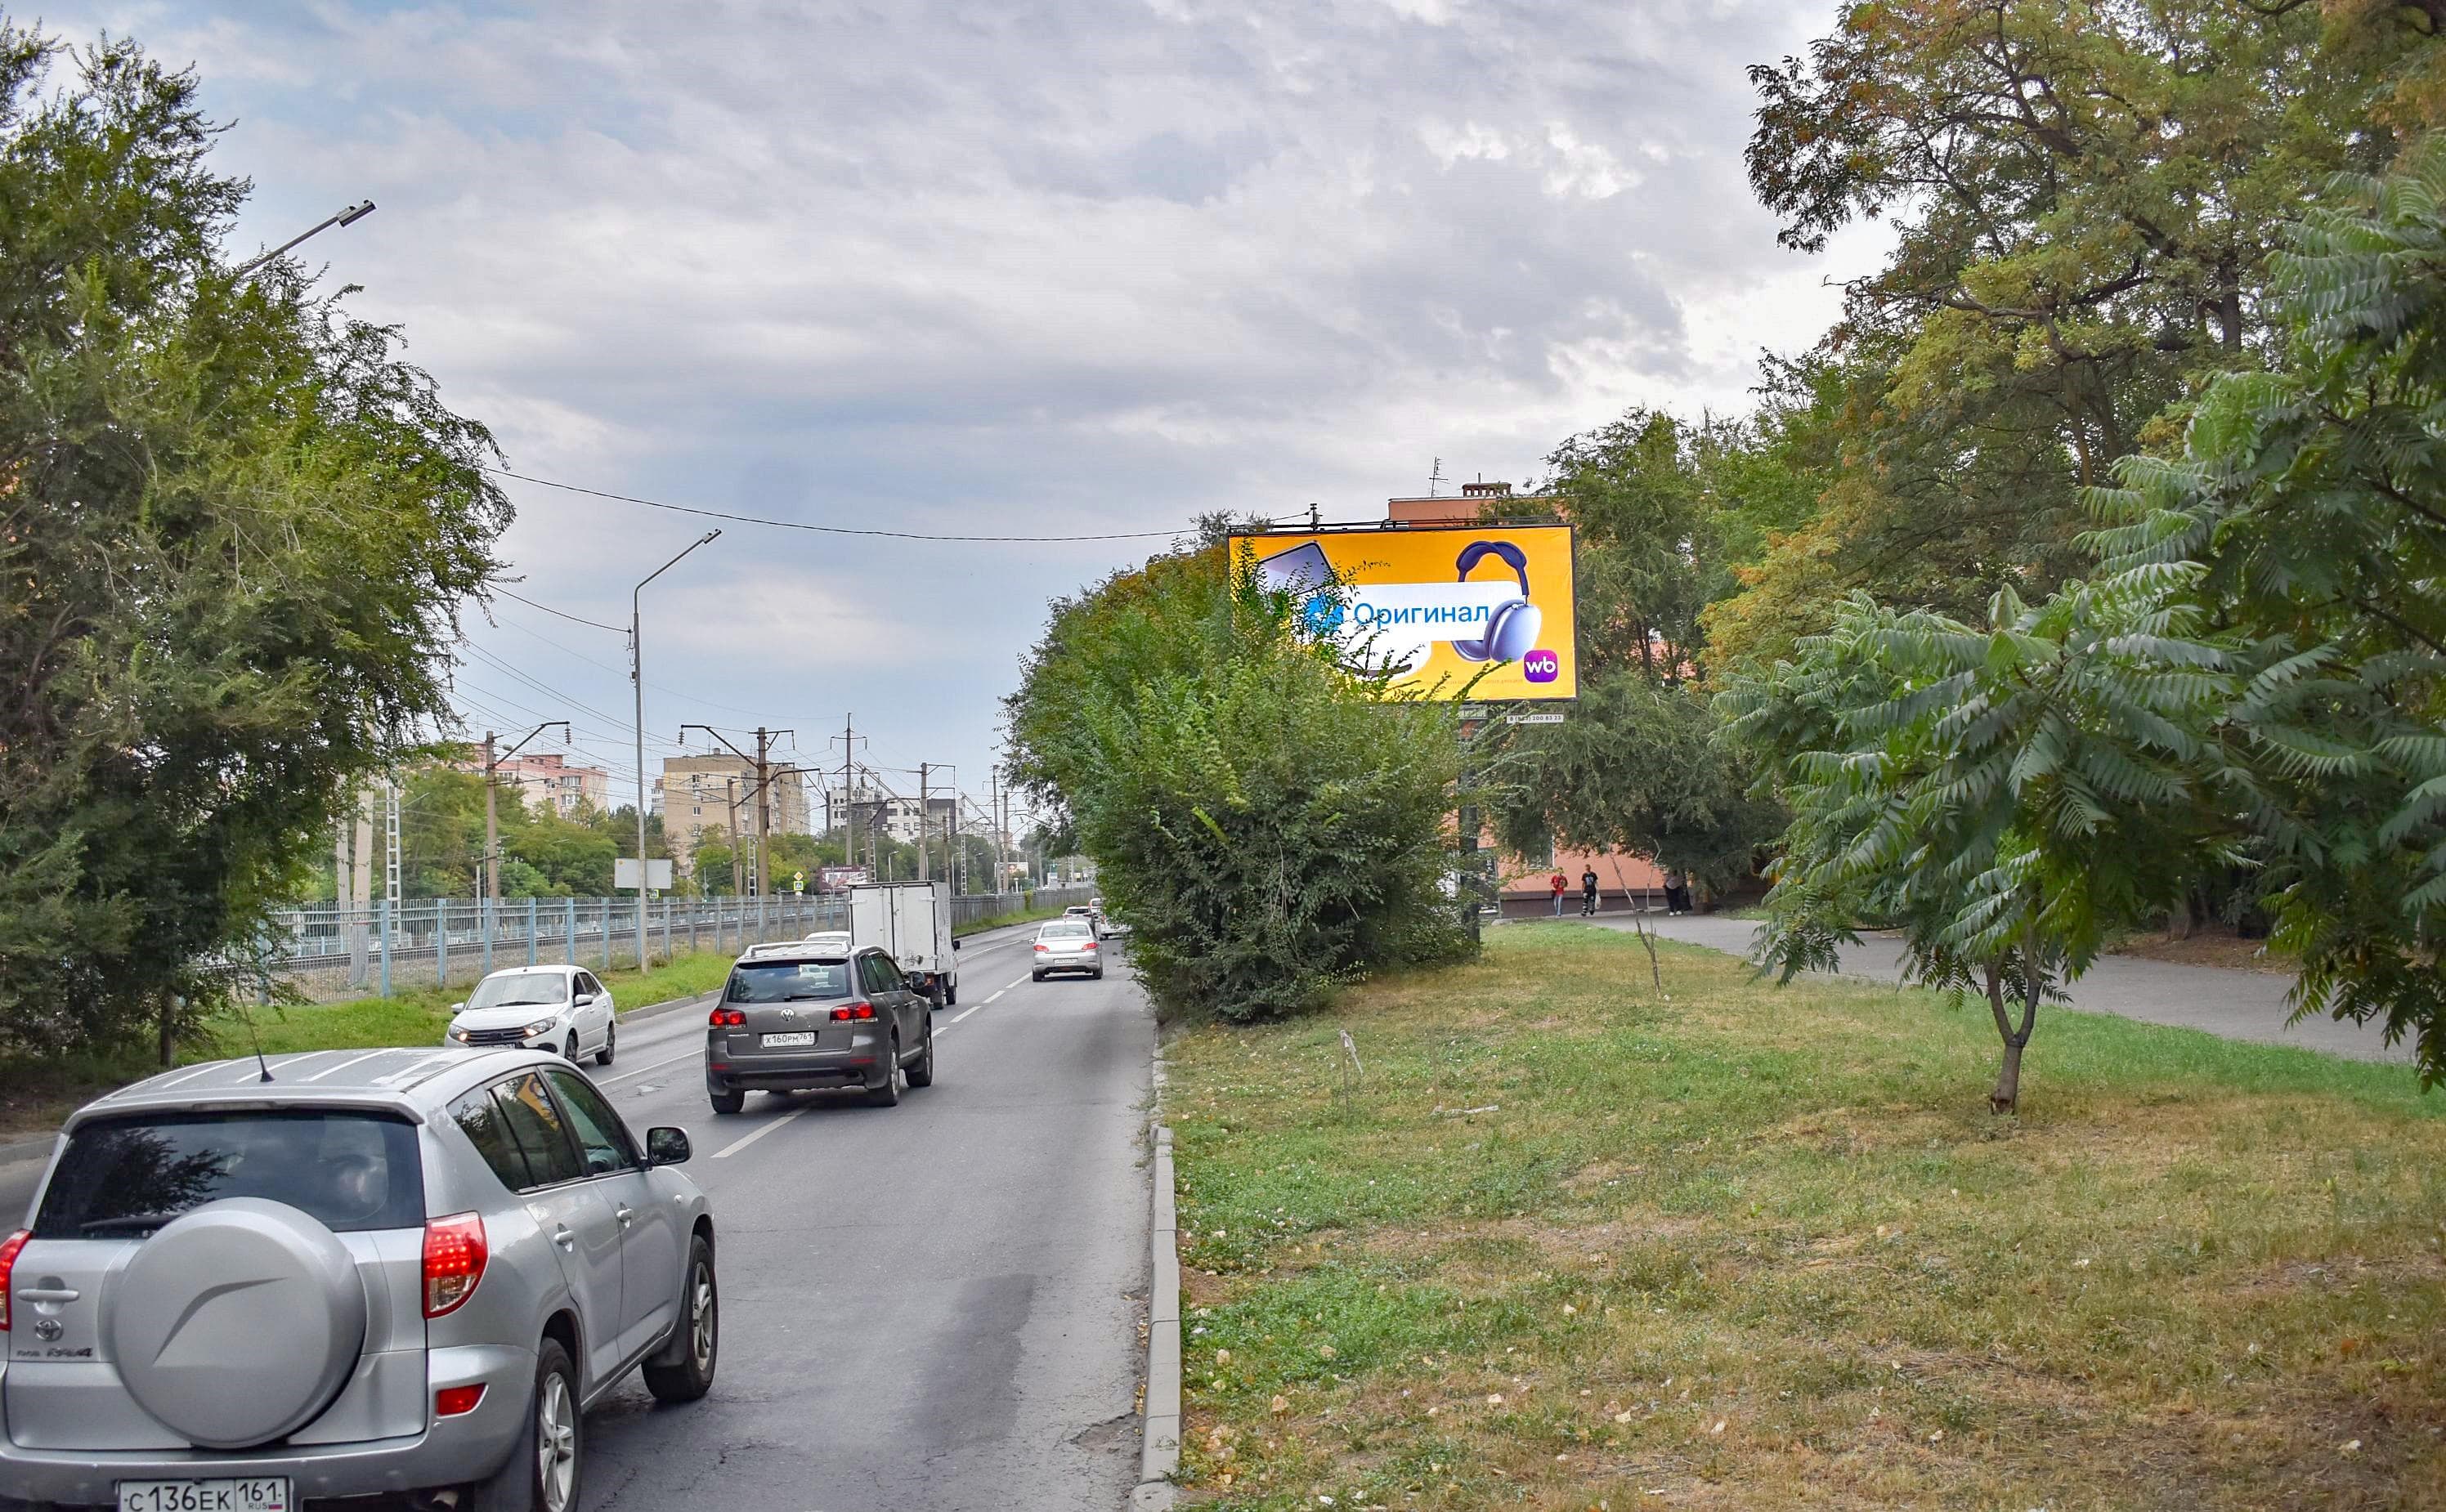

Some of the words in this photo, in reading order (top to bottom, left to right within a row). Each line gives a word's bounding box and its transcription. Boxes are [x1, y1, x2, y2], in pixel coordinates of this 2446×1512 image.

[1354, 602, 1489, 629] Оригинал
[1525, 656, 1557, 673] wb
[238, 1481, 277, 1502] 161
[248, 1502, 268, 1510] RUS
